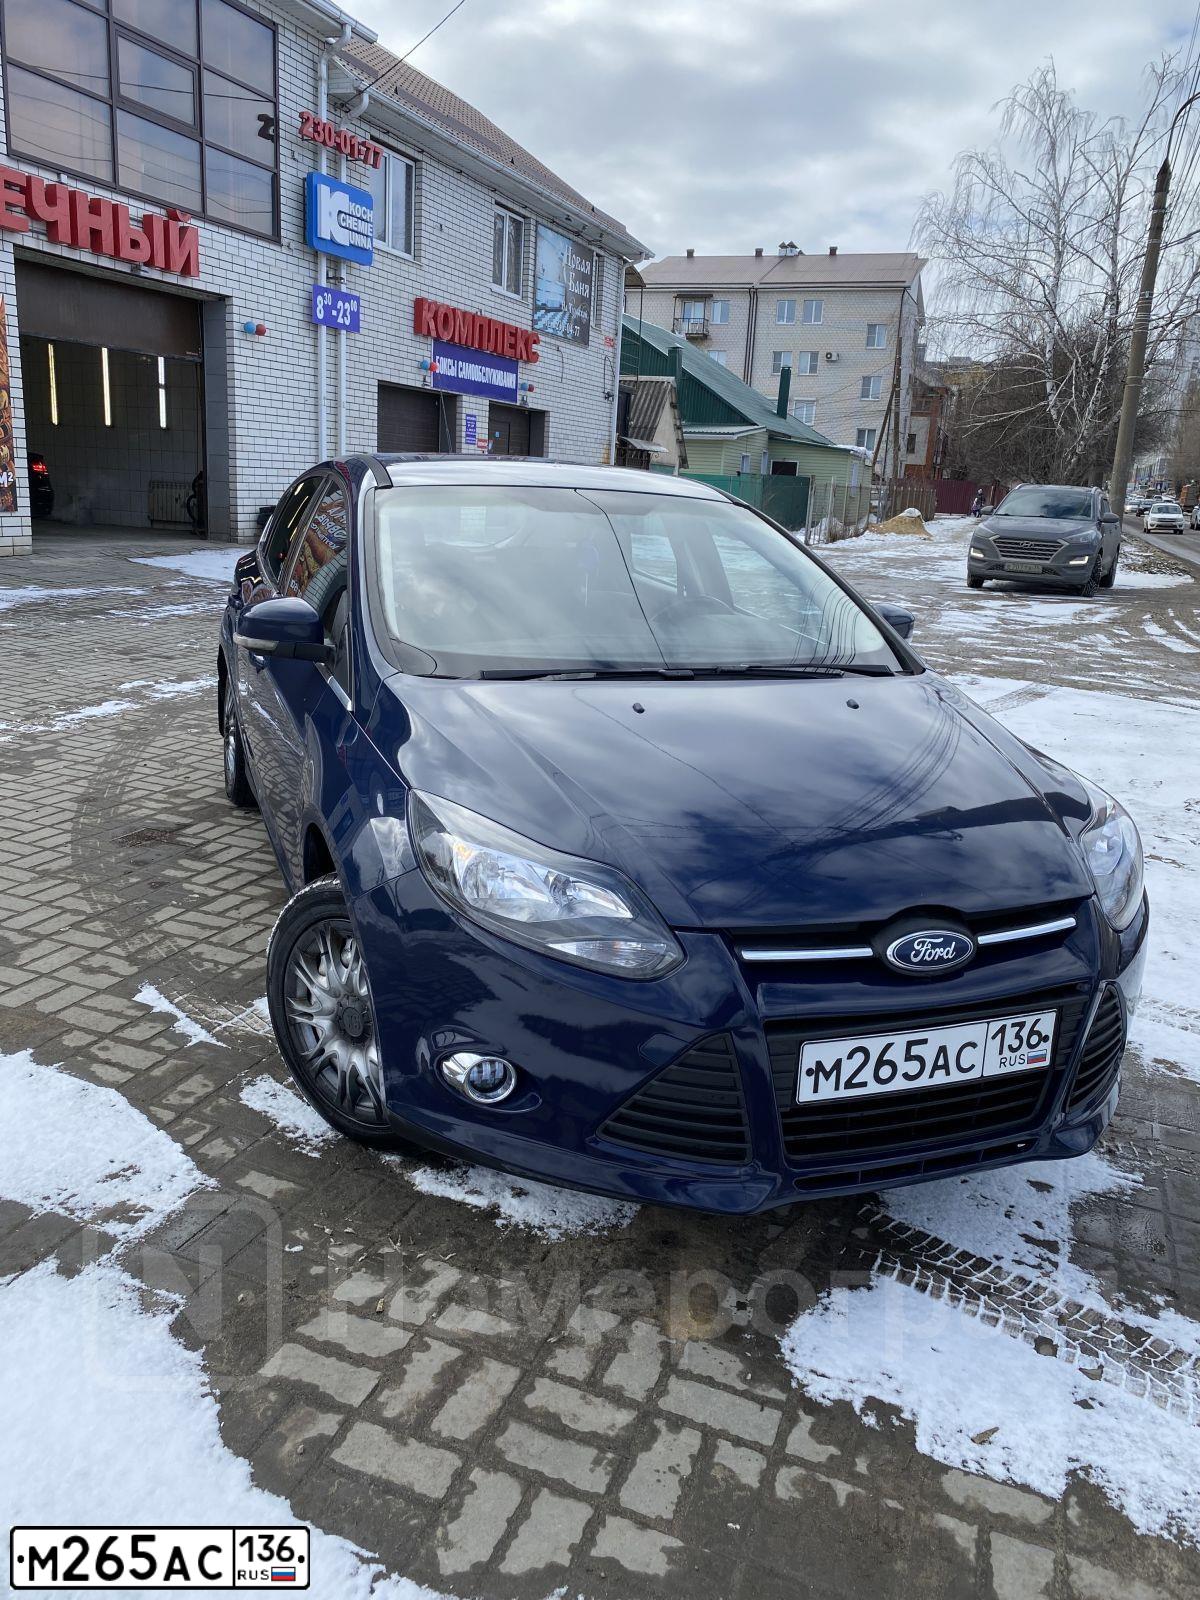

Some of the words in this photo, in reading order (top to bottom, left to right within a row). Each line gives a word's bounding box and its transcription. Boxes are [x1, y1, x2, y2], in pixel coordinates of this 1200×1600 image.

[299, 111, 384, 169] 230-01-77
[349, 201, 373, 222] KOCH
[340, 213, 373, 237] CHEMIE
[349, 230, 373, 251] UNNA
[414, 297, 540, 364] КОМПЛЕКС
[434, 355, 459, 379] БОКСЫ
[910, 937, 956, 963] Ford
[990, 1018, 1042, 1056] 136
[998, 1053, 1027, 1069] RUS
